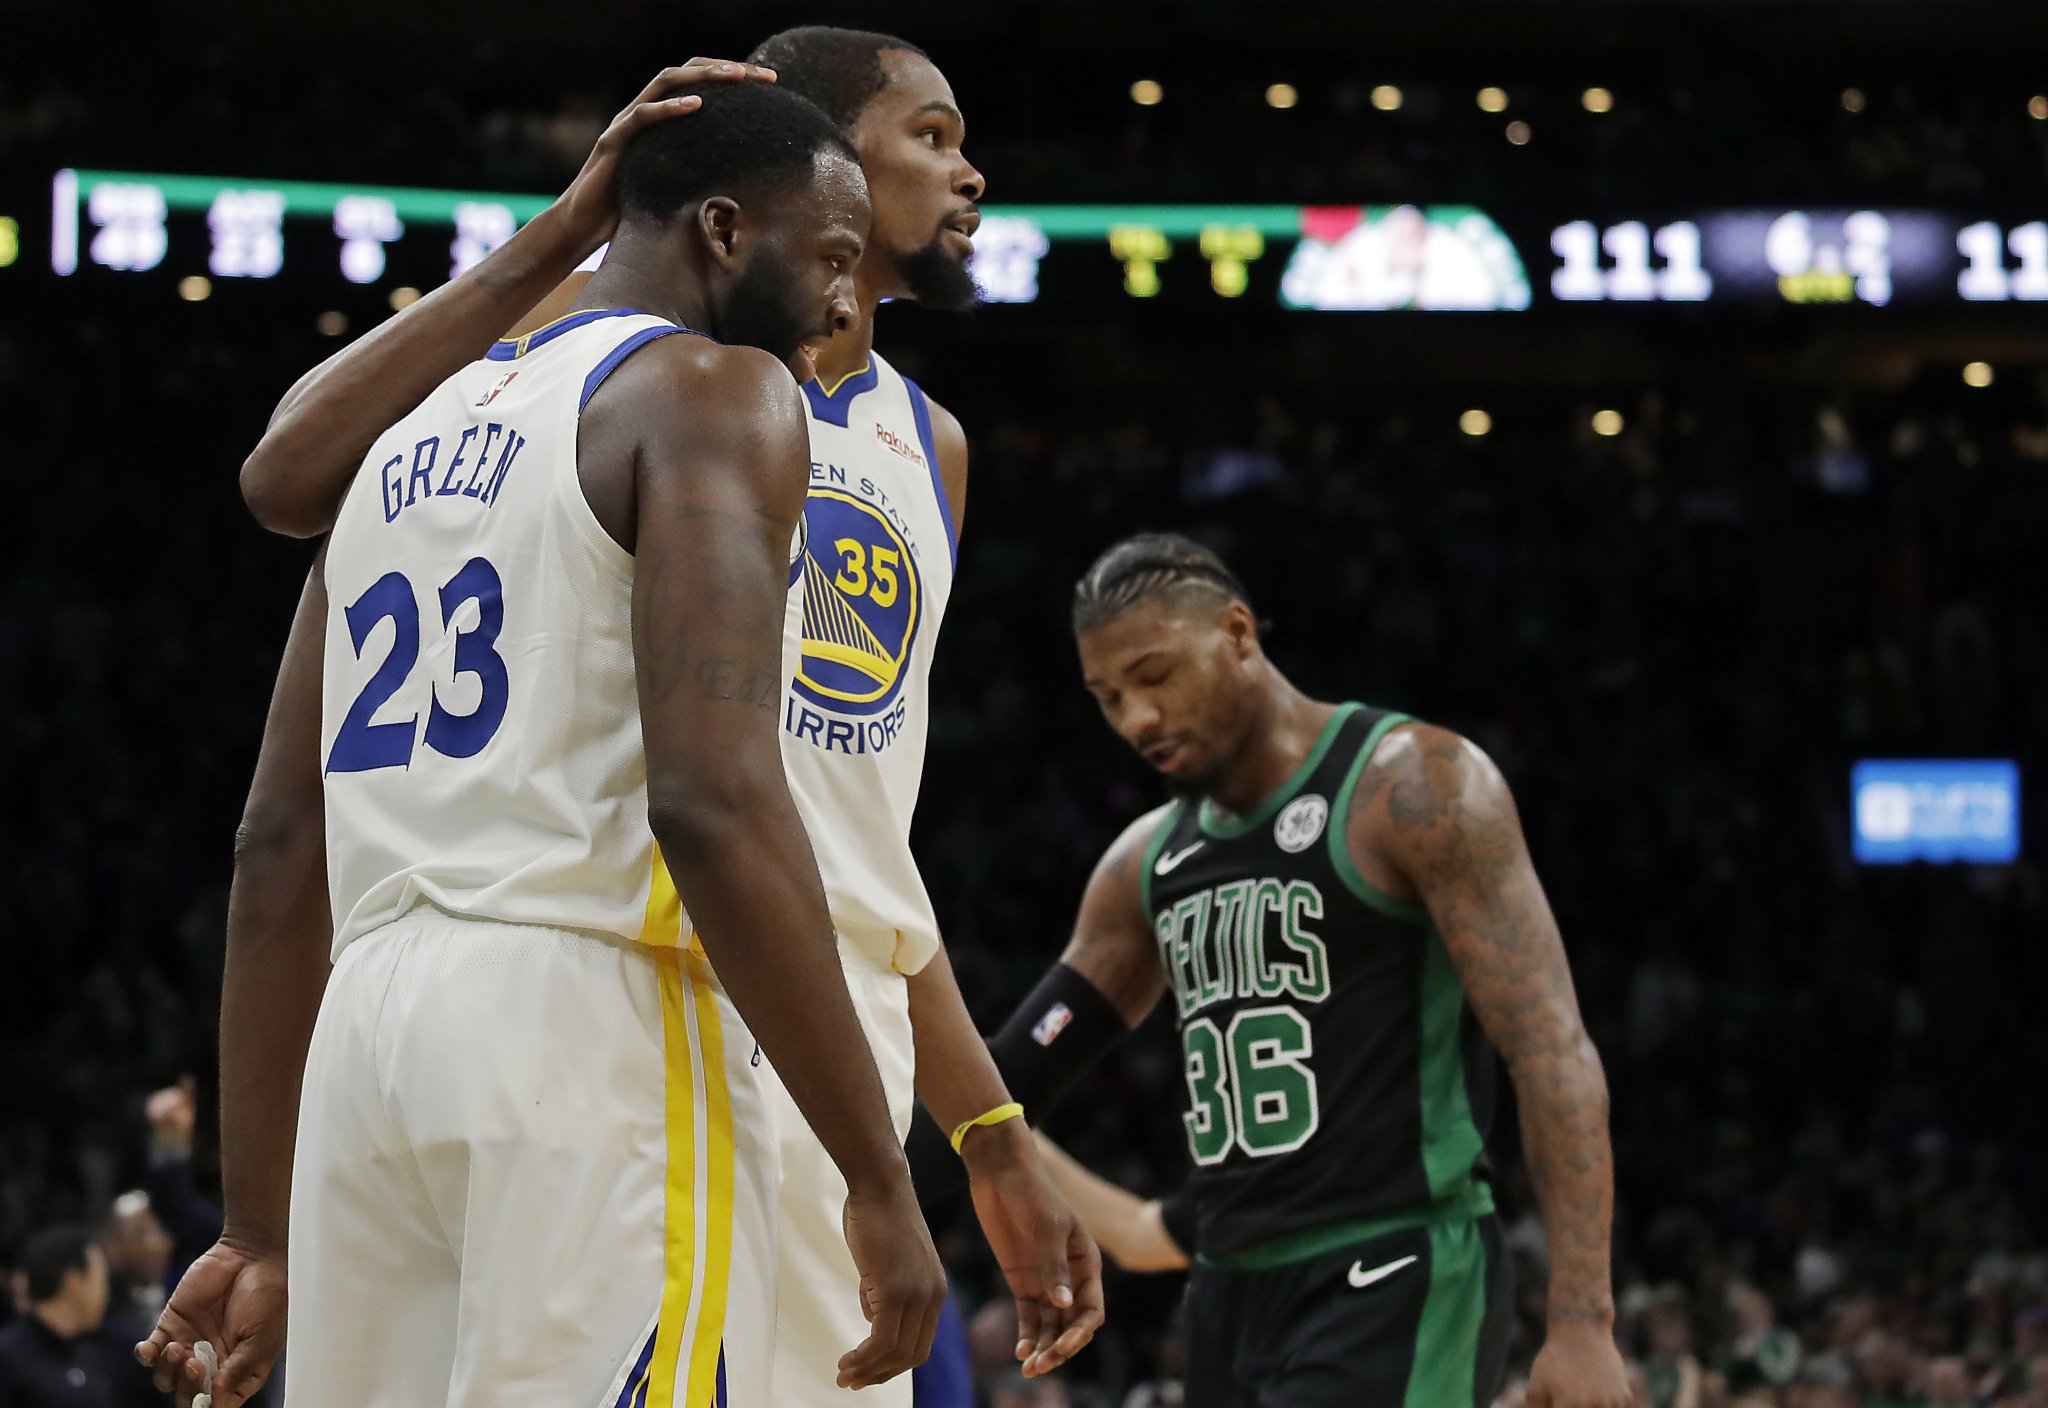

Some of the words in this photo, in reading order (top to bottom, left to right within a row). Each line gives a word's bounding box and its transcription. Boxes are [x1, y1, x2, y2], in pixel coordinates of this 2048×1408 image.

[1551, 221, 1712, 300] 111
[381, 422, 525, 523] GREEN
[876, 422, 927, 470] Rakuten
[834, 538, 899, 608] 35
[325, 556, 509, 779] 23
[1183, 1005, 1319, 1166] 36
